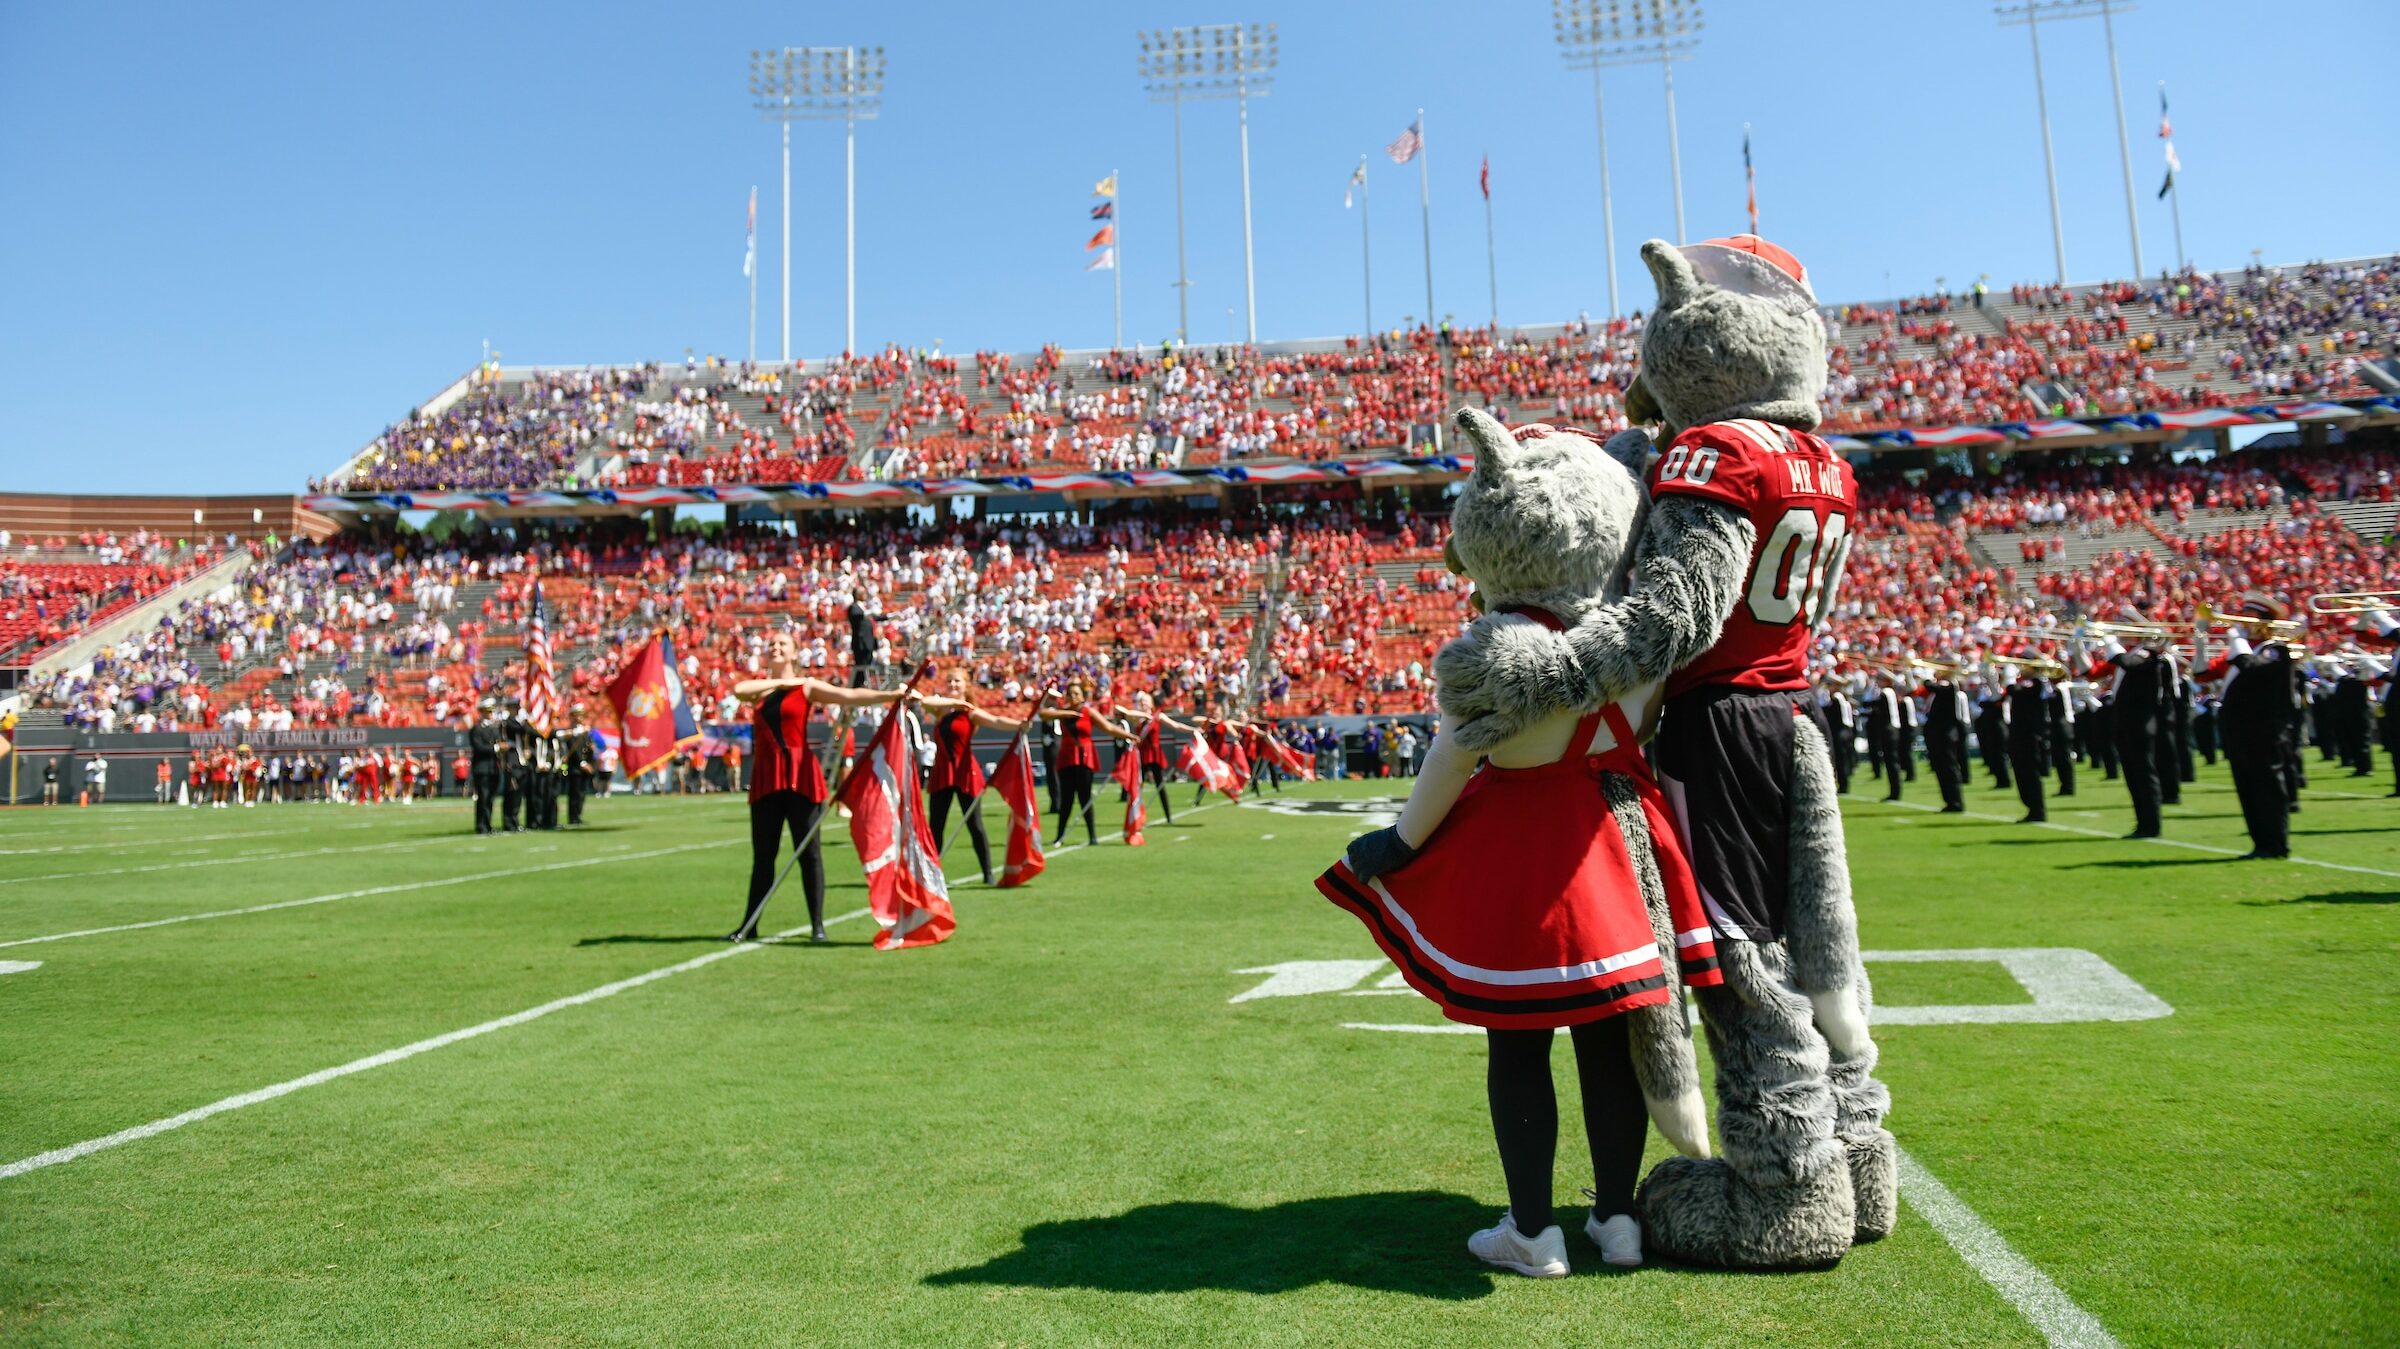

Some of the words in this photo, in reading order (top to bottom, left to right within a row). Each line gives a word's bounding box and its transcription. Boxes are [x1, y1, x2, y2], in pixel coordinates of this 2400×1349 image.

[1660, 445, 1719, 486] 00
[1785, 458, 1818, 494] MR.
[1748, 507, 1846, 626] 00
[189, 732, 237, 747] WAYNE
[242, 731, 270, 746] DAY
[275, 729, 324, 745] FAMILY
[329, 728, 367, 744] FIELD
